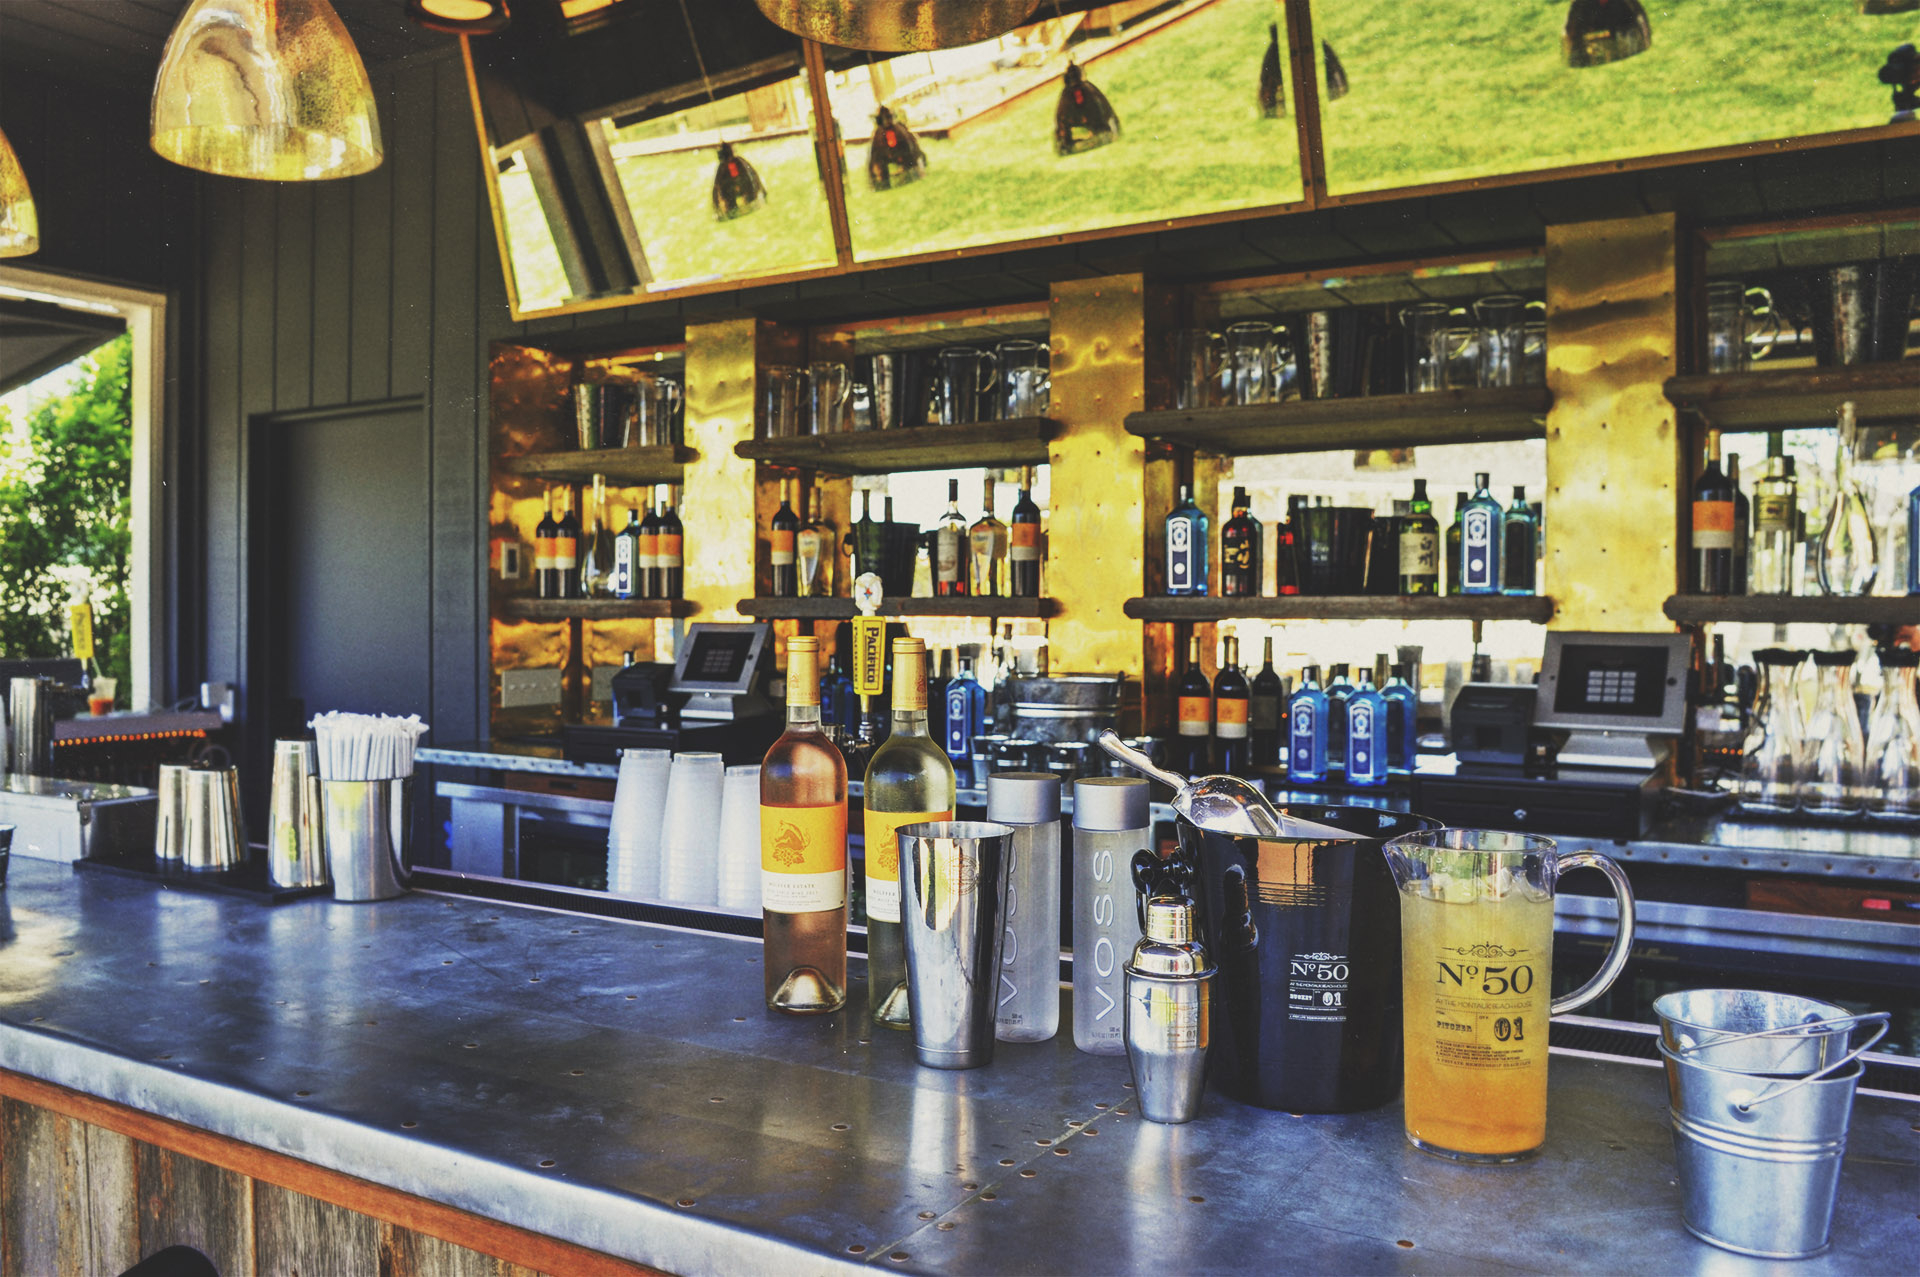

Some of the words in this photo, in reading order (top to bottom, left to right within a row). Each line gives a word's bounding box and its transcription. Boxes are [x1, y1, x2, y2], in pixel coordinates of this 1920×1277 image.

[866, 627, 879, 684] PACIFICO
[1093, 850, 1116, 1021] VOSS
[1322, 991, 1341, 1006] 01
[1436, 1021, 1472, 1032] PITCHER
[1494, 1016, 1524, 1041] 01
